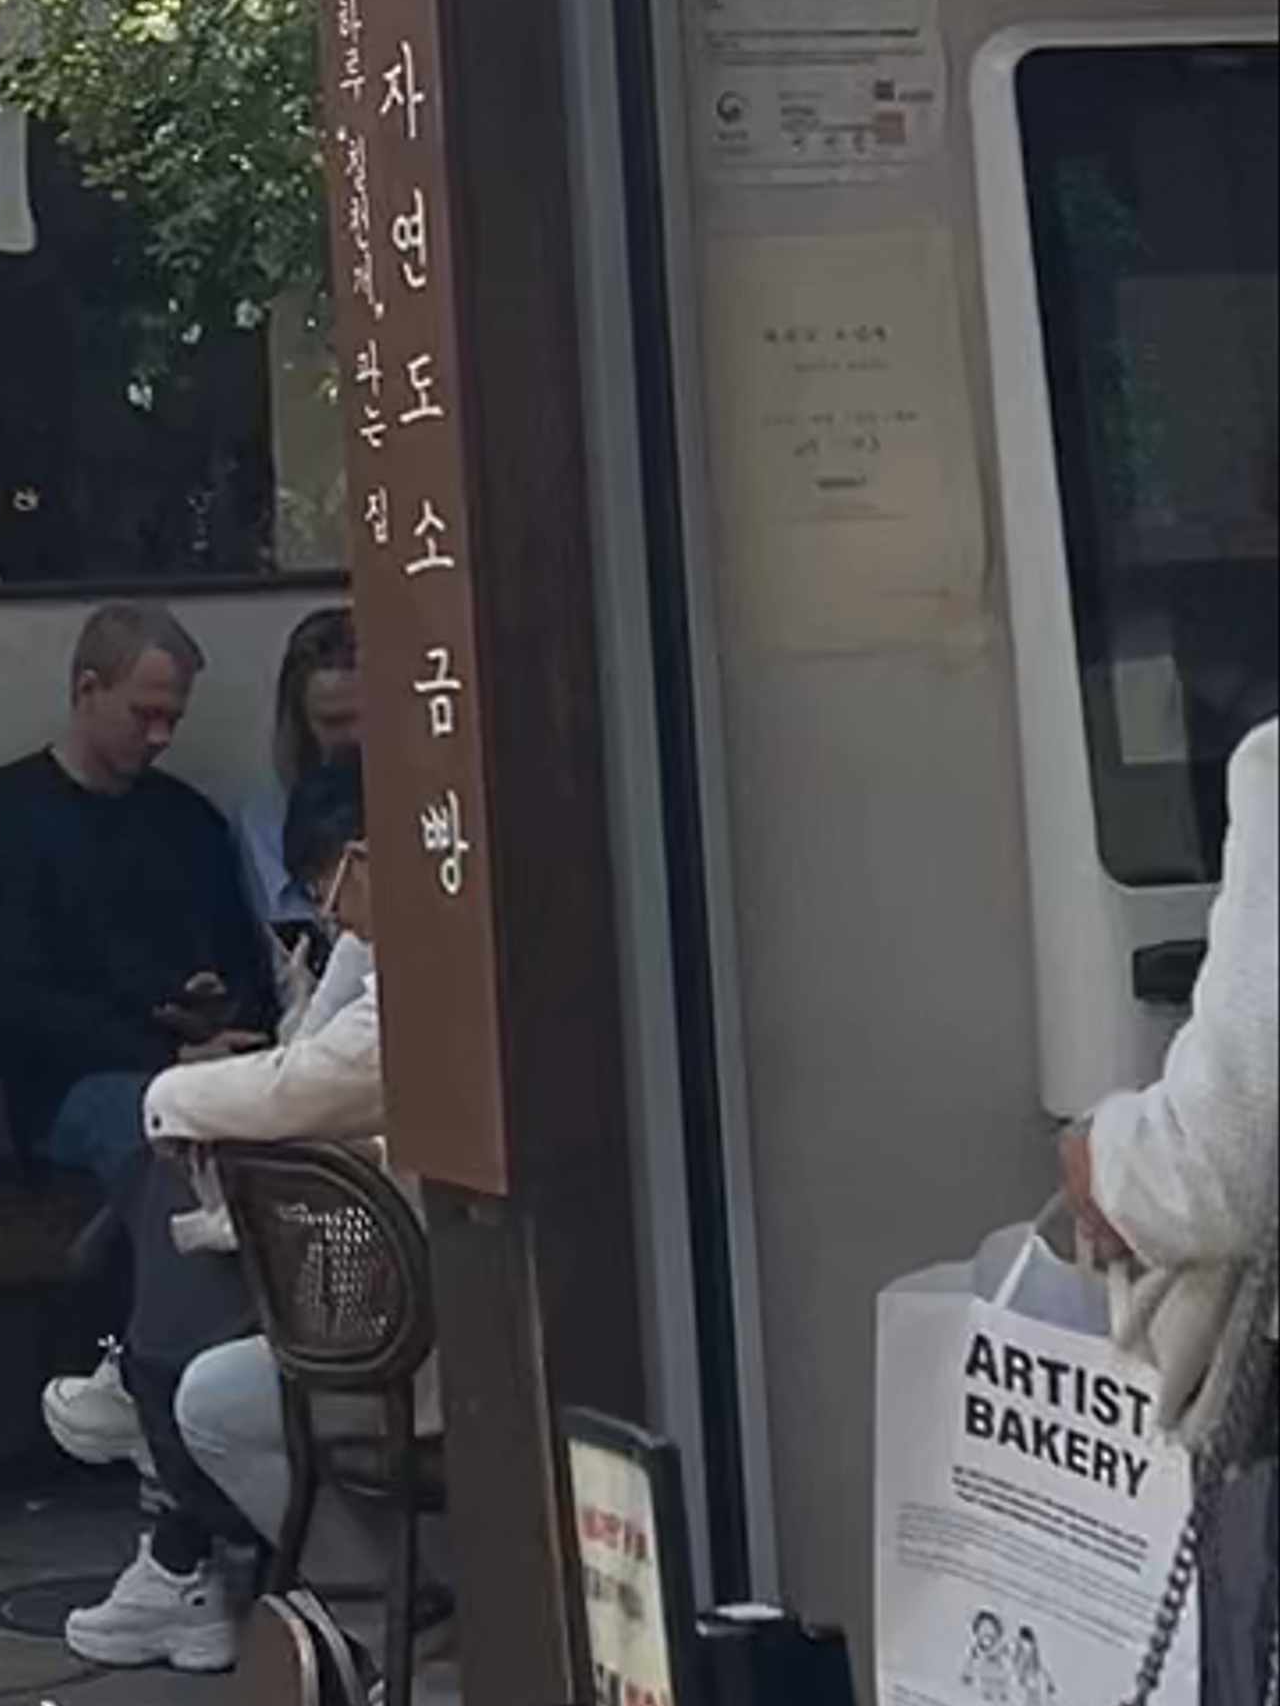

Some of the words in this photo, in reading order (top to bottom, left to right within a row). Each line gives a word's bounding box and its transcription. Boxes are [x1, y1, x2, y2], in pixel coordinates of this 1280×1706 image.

[355, 340, 387, 448] 파는
[363, 488, 389, 543] 집
[965, 1333, 1152, 1437] ARTIST
[965, 1394, 1150, 1498] BAKERY
